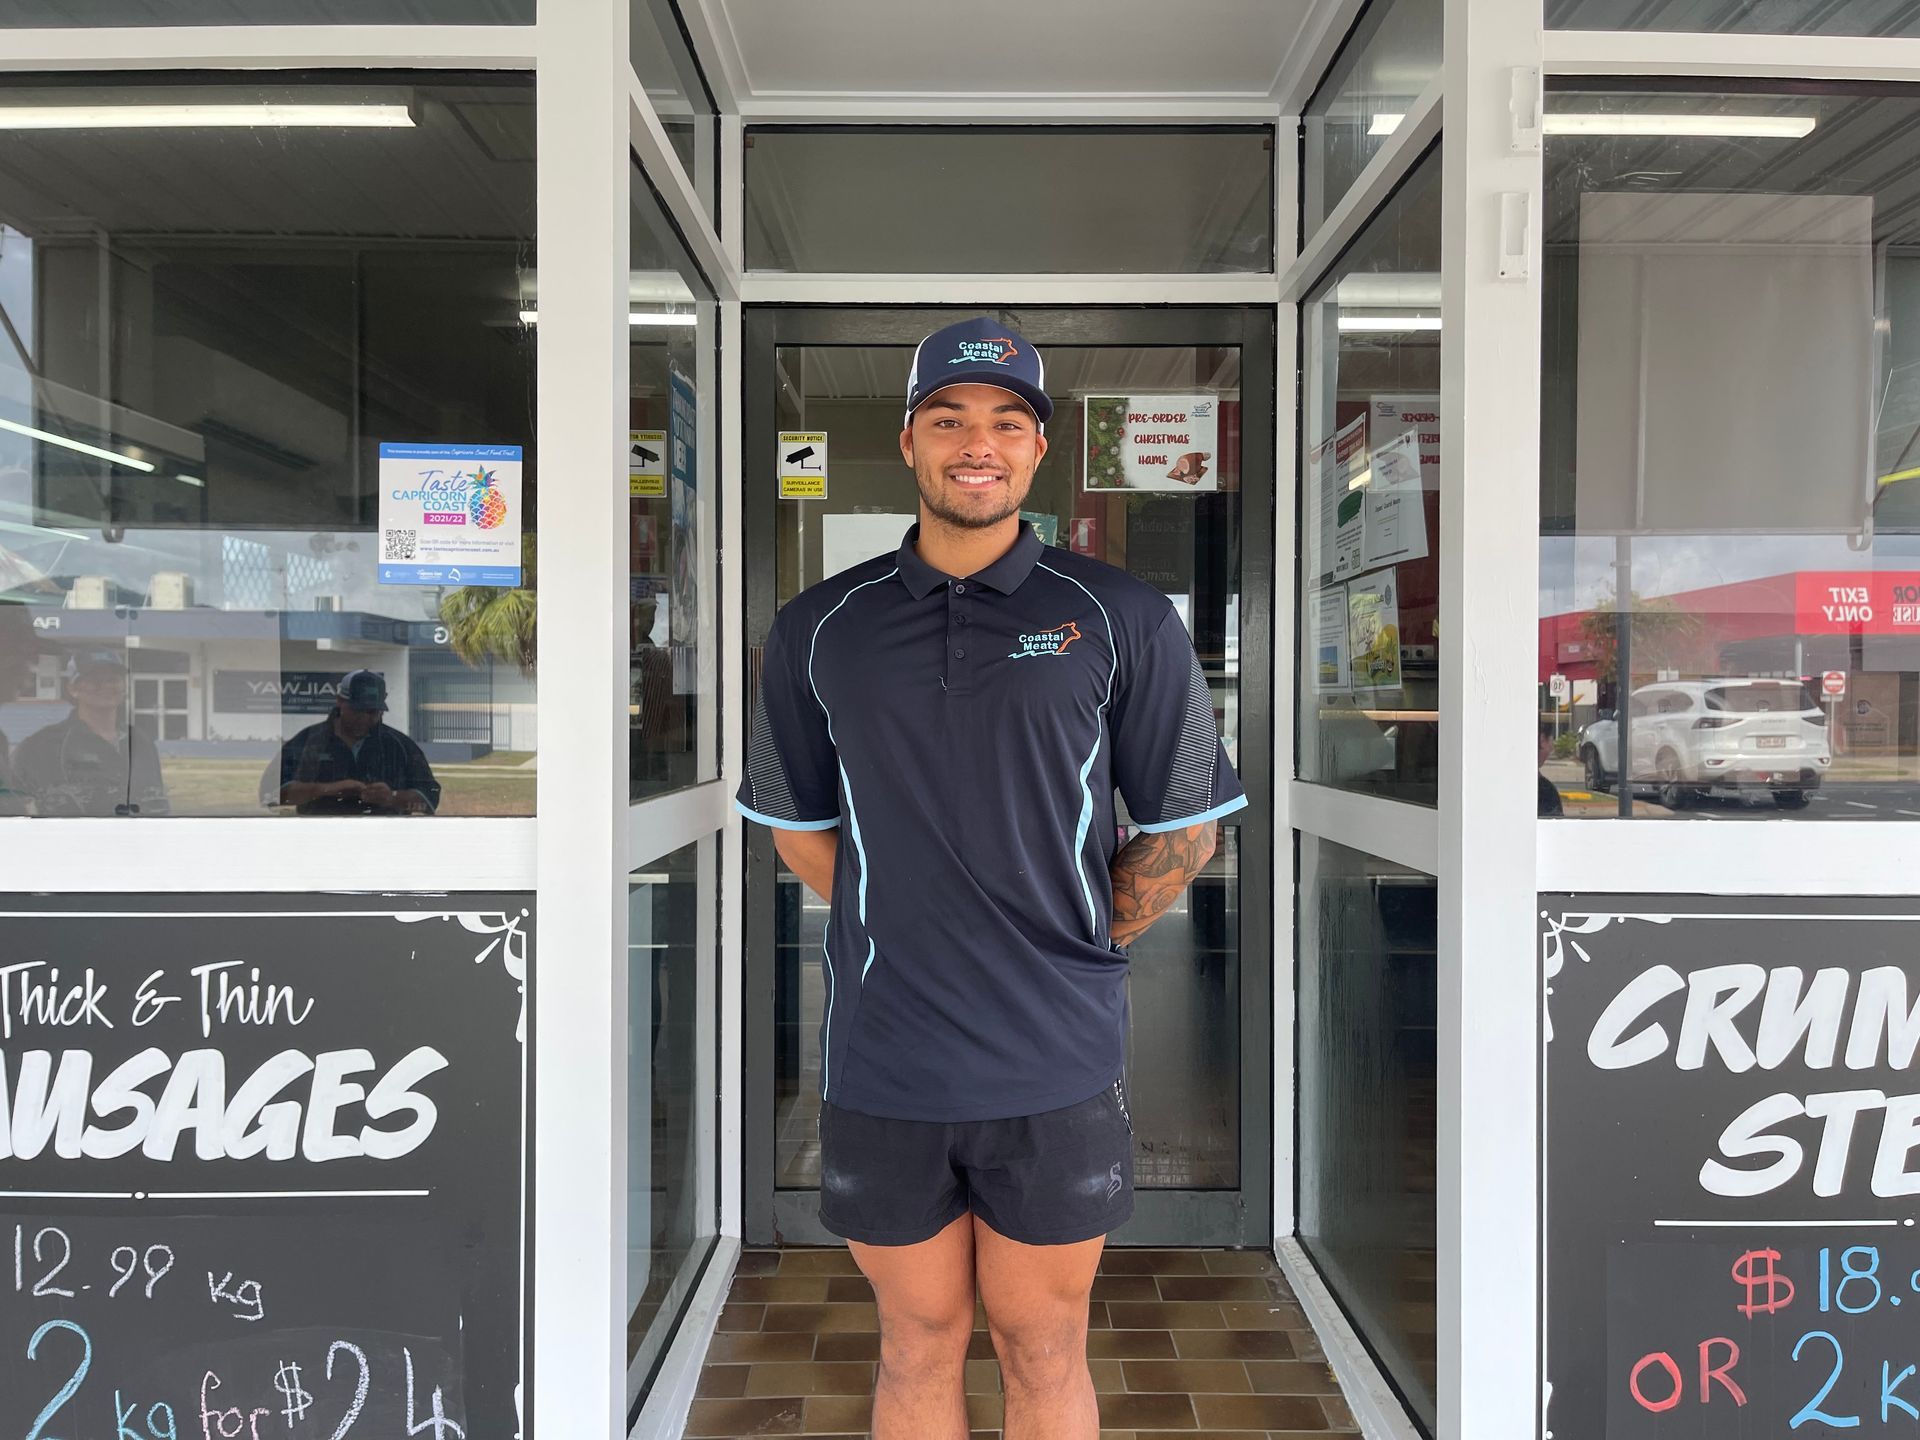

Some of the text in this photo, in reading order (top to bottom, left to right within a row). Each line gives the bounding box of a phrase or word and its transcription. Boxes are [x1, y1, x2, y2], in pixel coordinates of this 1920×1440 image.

[959, 342, 1003, 353] Coastal
[963, 350, 999, 359] Meats
[1128, 413, 1187, 424] PRE-ORDER
[1134, 434, 1190, 445] CHRISTMAS
[418, 470, 469, 493] Taste
[392, 490, 467, 501] CAPRICORN
[423, 501, 467, 512] COAST
[429, 515, 463, 523] 2021/22
[1019, 632, 1064, 643] Coastal
[1023, 641, 1059, 650] Meats
[0, 960, 314, 1039] Thick & Thin
[0, 1046, 449, 1162] USAGES
[1731, 1246, 1920, 1319] $18.
[207, 1271, 264, 1321] kg
[1629, 1337, 1748, 1413] OR
[199, 1370, 271, 1440] for
